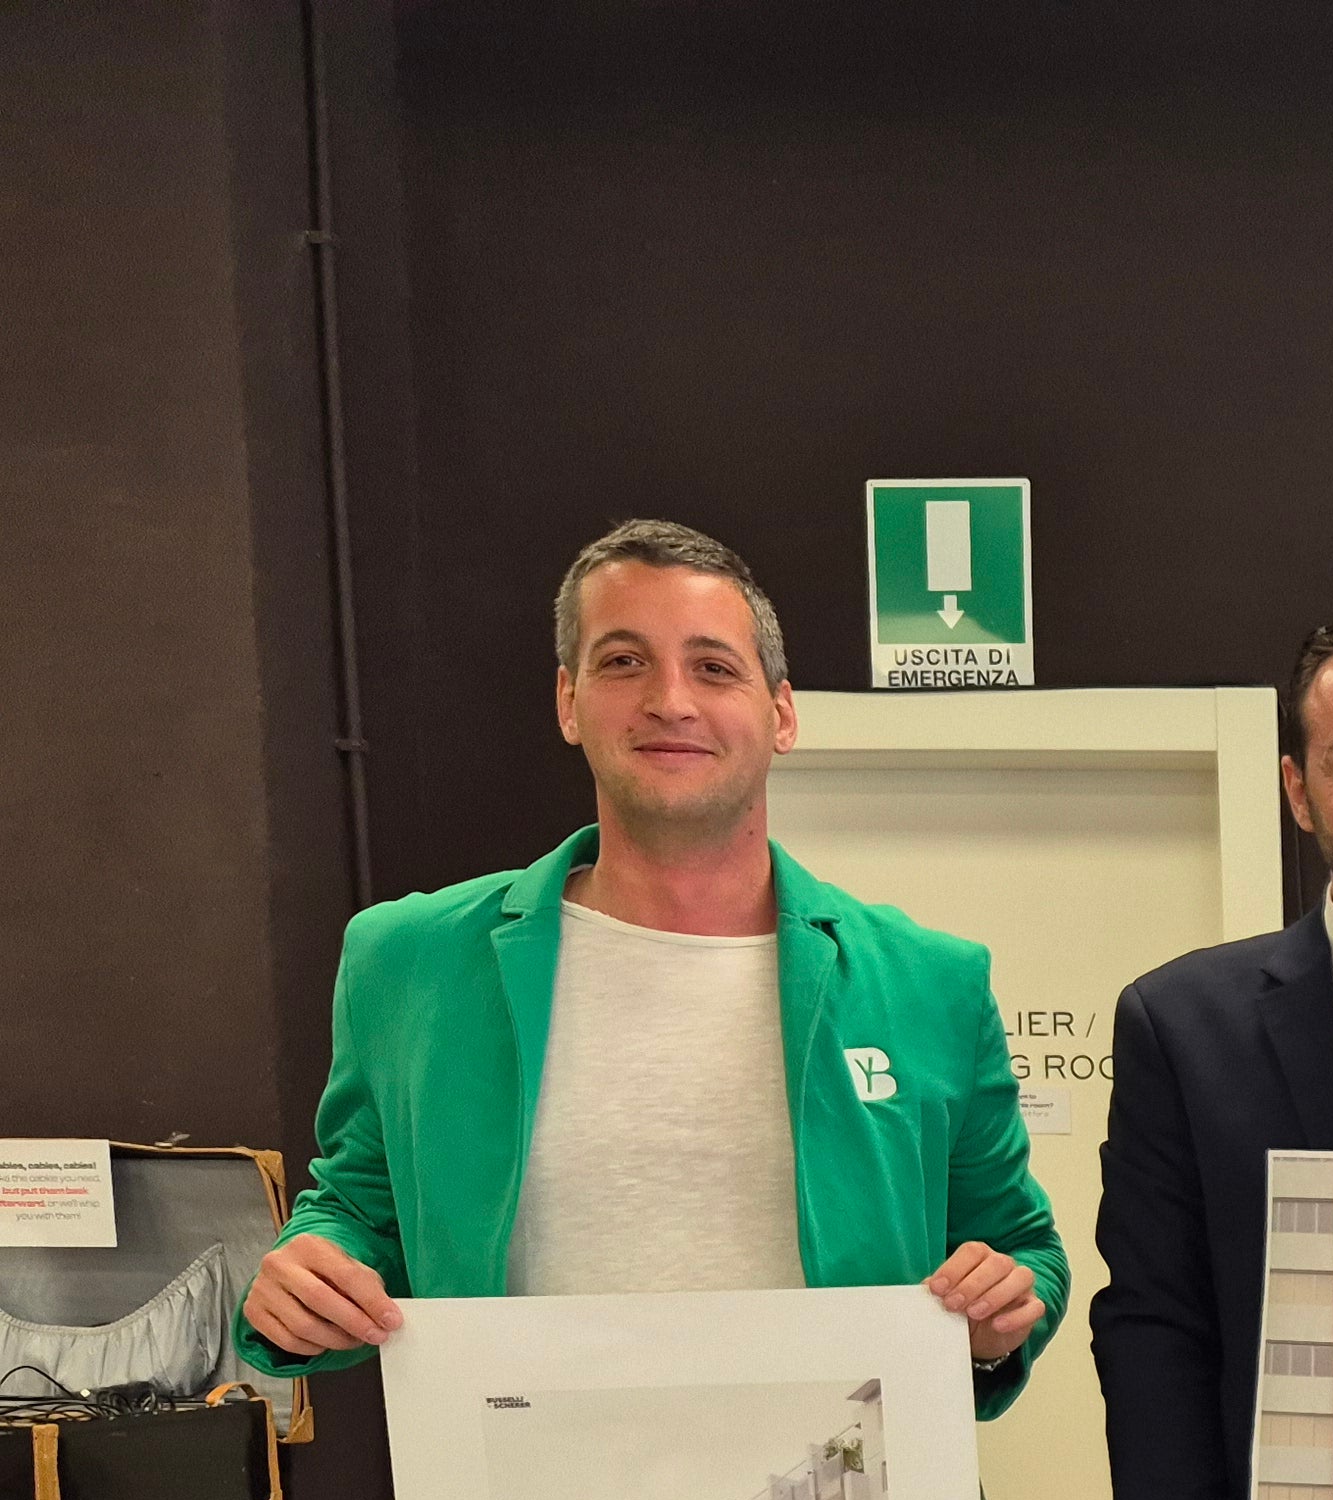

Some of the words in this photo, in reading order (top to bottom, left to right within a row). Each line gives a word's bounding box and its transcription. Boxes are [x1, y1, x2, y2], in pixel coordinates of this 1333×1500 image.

[894, 648, 978, 666] USCITA
[988, 647, 1011, 666] DI
[888, 669, 1019, 687] EMERGENZA
[1044, 1054, 1114, 1079] ROO
[0, 1162, 27, 1171] ables,
